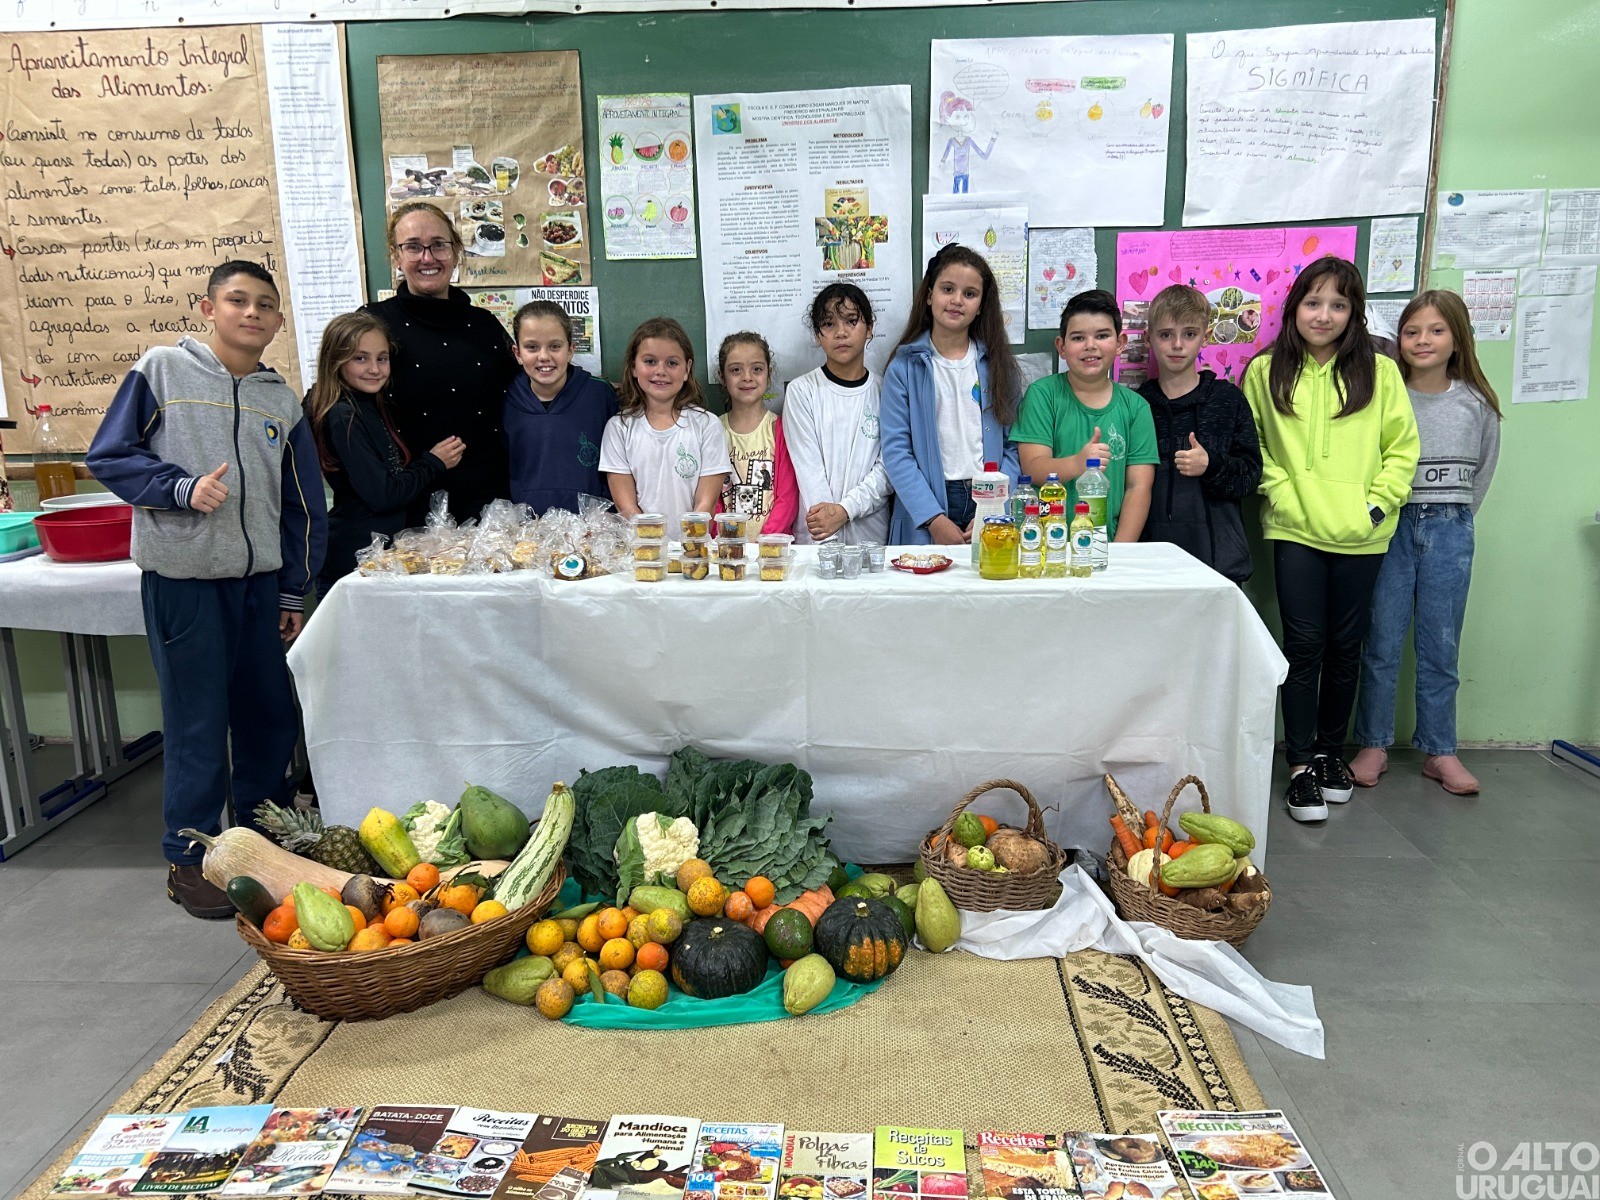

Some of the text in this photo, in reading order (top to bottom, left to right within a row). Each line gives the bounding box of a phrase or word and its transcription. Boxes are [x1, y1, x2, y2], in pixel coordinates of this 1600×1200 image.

[178, 34, 249, 78] Integral
[1211, 39, 1226, 59] O
[98, 74, 214, 99] Alimentos:
[6, 117, 253, 142] Consiste no consumo de todos
[32, 156, 75, 179] quase
[137, 154, 157, 167] as
[167, 148, 209, 175] partes
[5, 176, 89, 201] alimentos
[98, 183, 137, 195] como:
[141, 175, 180, 194] talos,
[81, 235, 131, 259] partes
[185, 239, 208, 250] em
[19, 266, 55, 283] dades
[158, 266, 181, 289] que
[85, 294, 117, 312] para
[124, 293, 133, 306] o
[531, 288, 589, 301] NÃO DESPERDICE
[126, 321, 141, 333] a
[35, 348, 101, 364] do com
[44, 368, 117, 387] nutritivos
[1424, 467, 1450, 483] OF
[984, 483, 994, 491] 70
[414, 1113, 445, 1121] DOCE
[472, 1113, 531, 1127] Receitas
[618, 1121, 688, 1133] Mandioca
[701, 1126, 749, 1135] RECEITAS
[1177, 1121, 1288, 1132] RECEITAS CASEIRAS
[634, 1131, 686, 1140] Alimentação
[641, 1137, 677, 1145] Humana
[888, 1128, 953, 1147] Receitas
[980, 1131, 1047, 1147] Receitas
[784, 1135, 796, 1169] MONDIAL
[799, 1136, 850, 1158] Polpas
[913, 1144, 928, 1155] de
[896, 1149, 945, 1167] Sucos
[689, 1173, 714, 1182] 104
[180, 1182, 218, 1191] RECEITAS
[1011, 1187, 1067, 1195] ESTA TORTA
